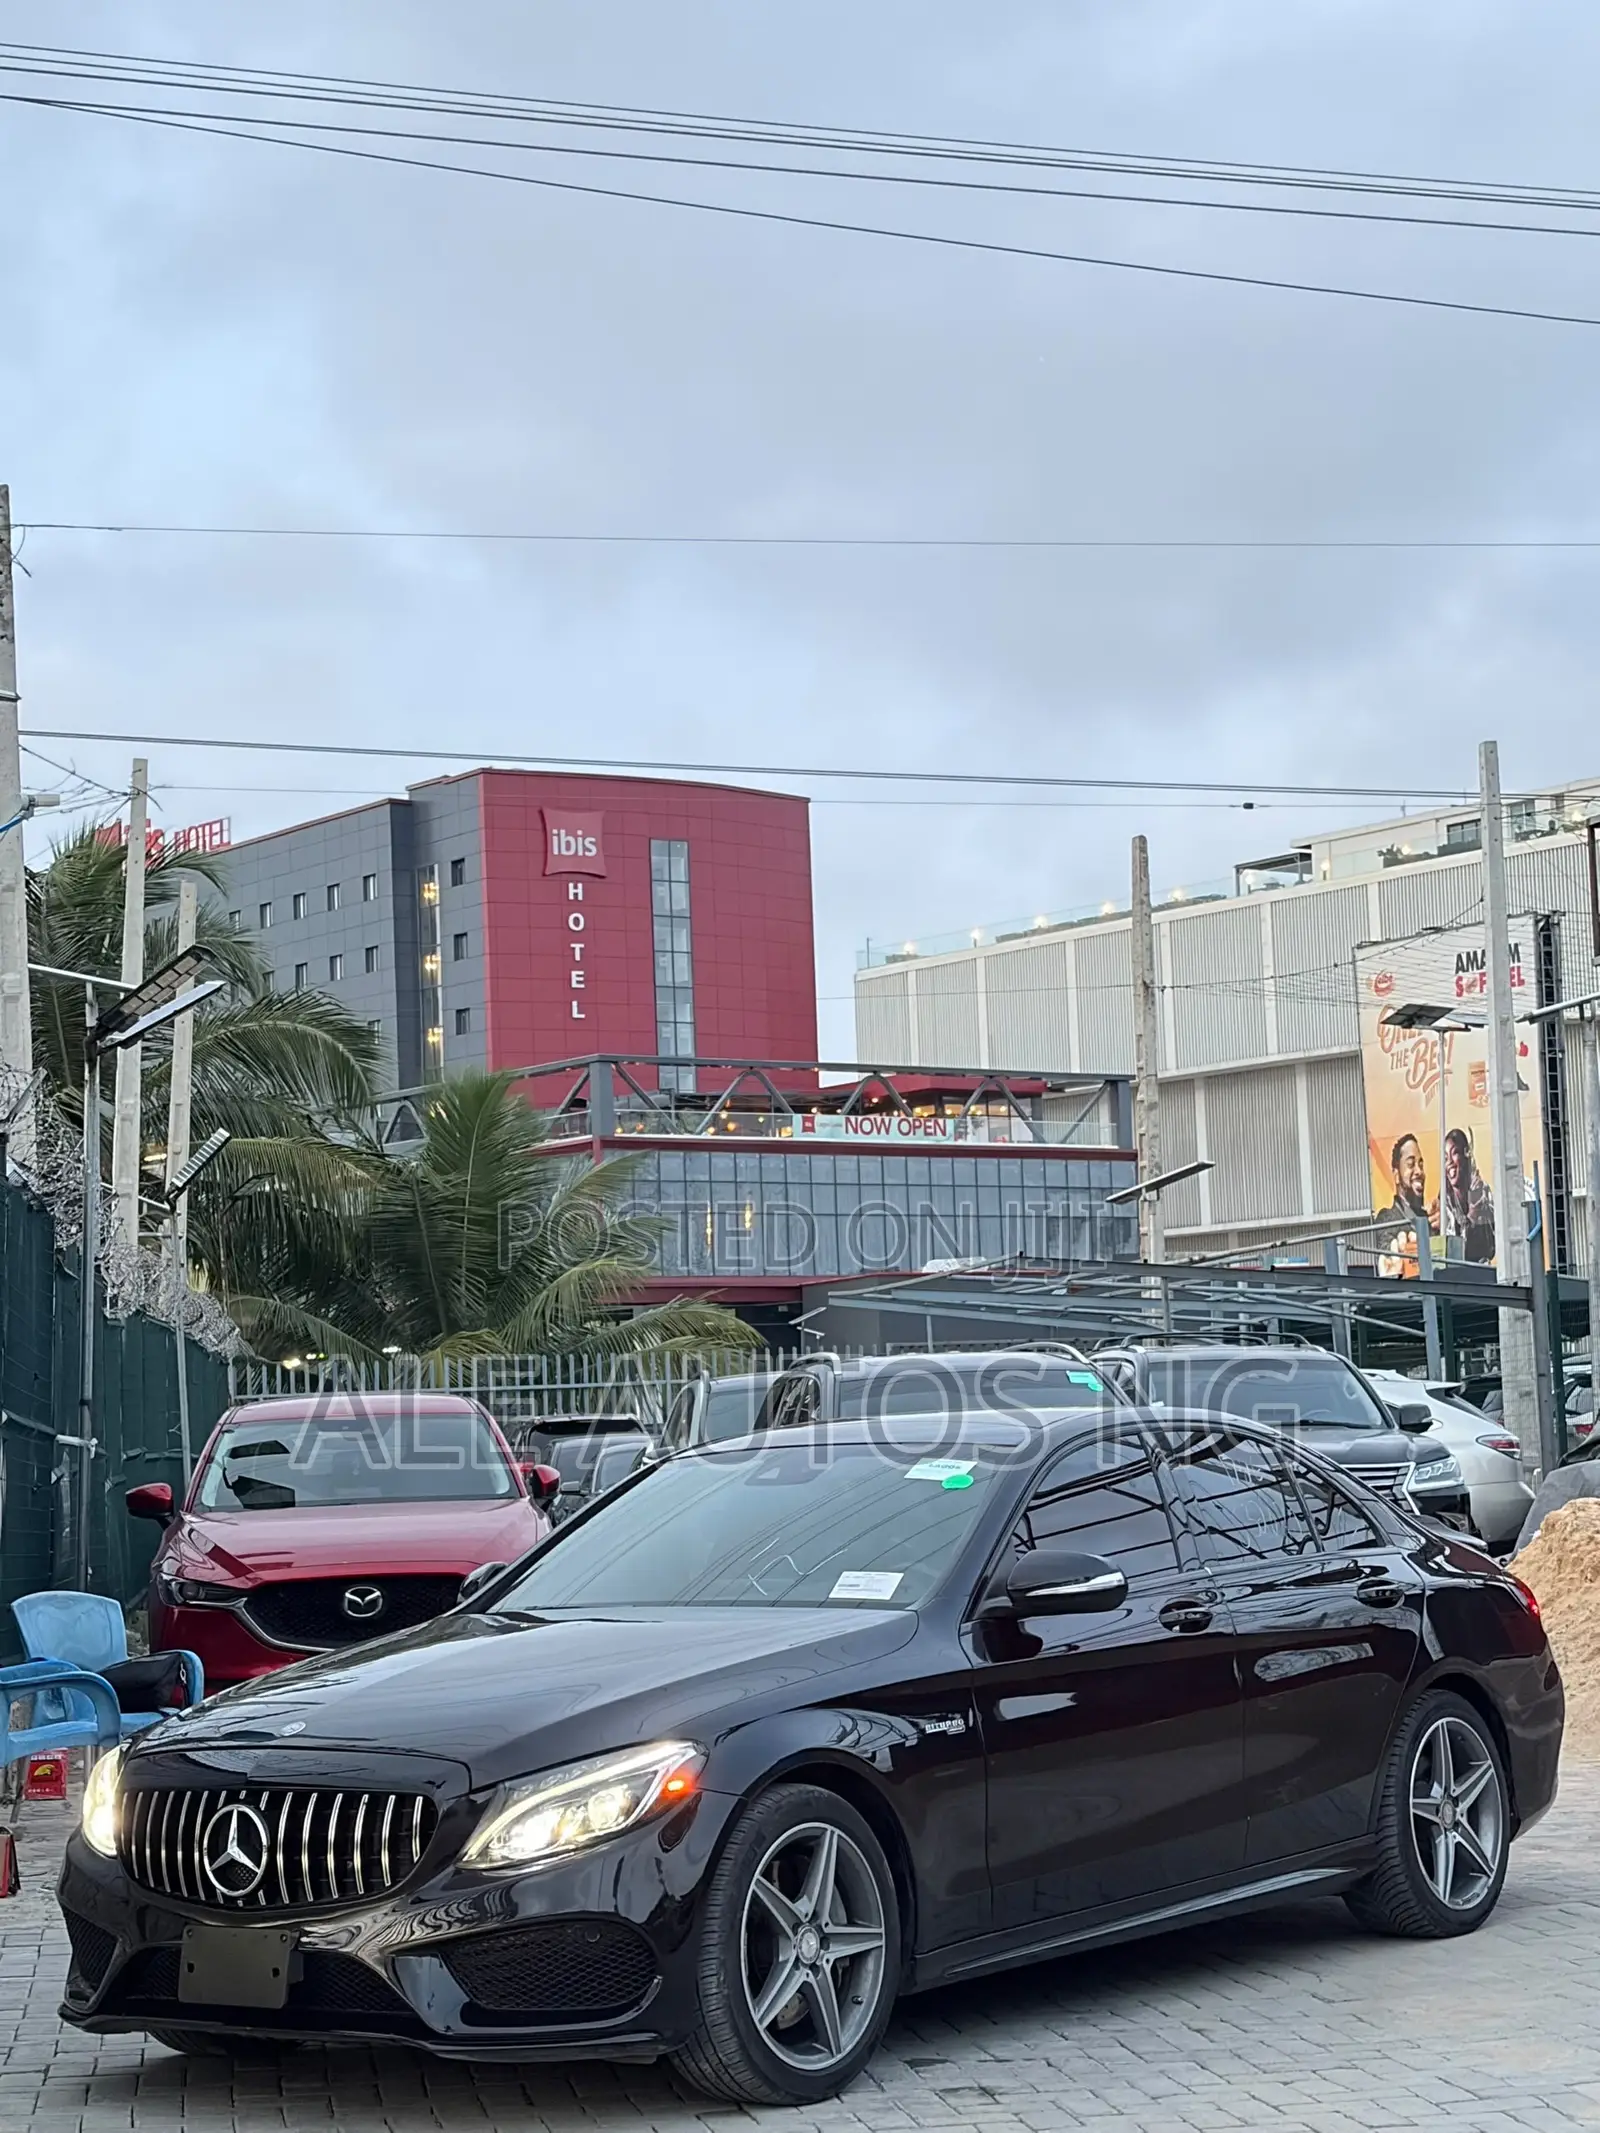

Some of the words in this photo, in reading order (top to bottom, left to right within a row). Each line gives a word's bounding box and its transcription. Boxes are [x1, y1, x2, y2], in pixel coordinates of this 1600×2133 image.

[552, 829, 597, 857] ibis
[568, 882, 586, 1019] HOTEL
[1390, 1048, 1410, 1071] THE
[844, 1116, 892, 1136] NOW
[897, 1118, 948, 1138] OPEN
